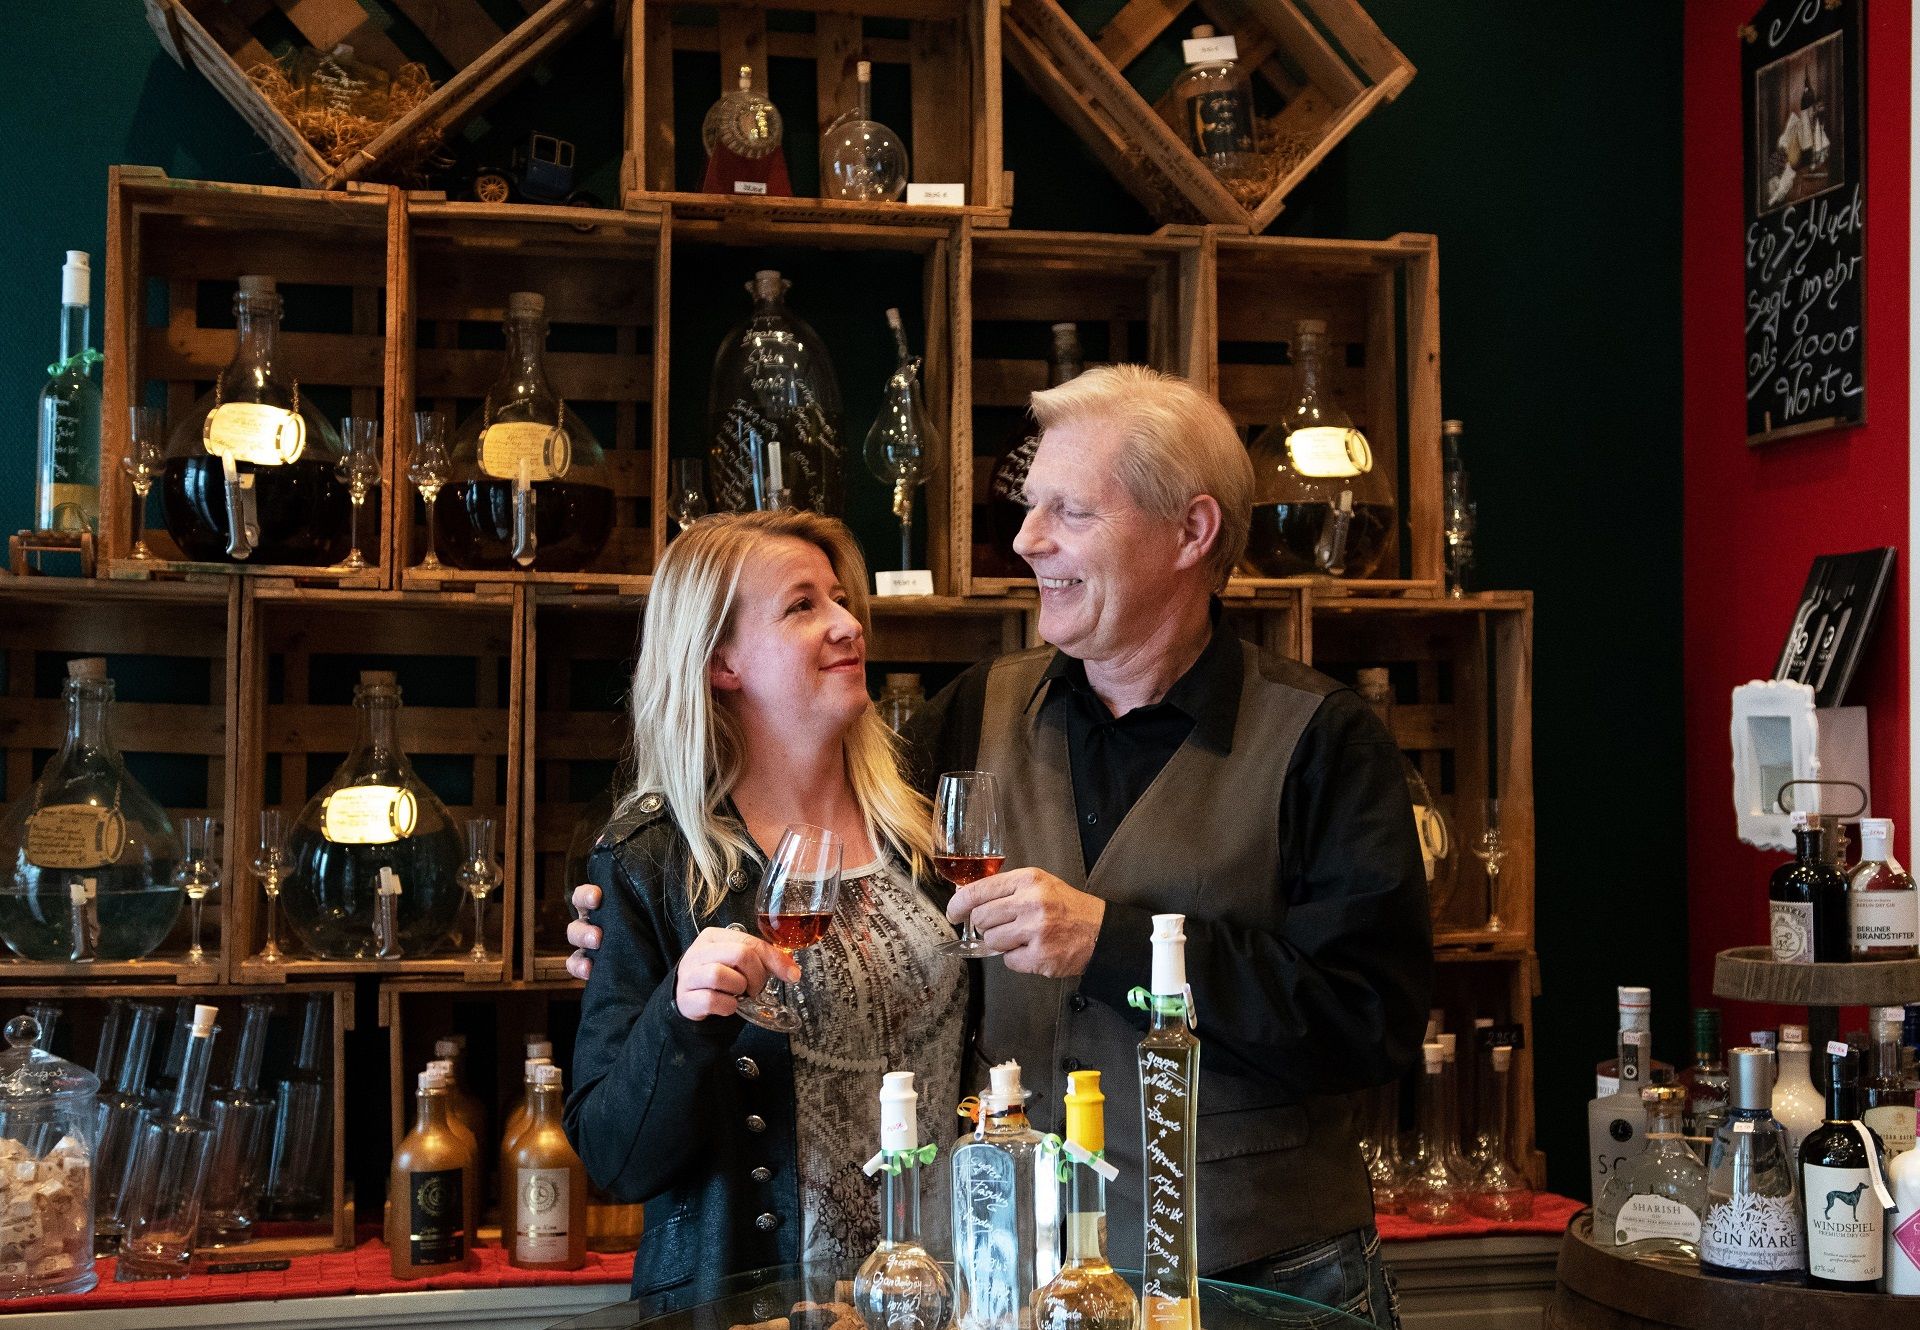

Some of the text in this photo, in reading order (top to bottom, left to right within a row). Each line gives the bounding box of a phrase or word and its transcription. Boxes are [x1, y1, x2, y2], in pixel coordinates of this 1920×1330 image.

[1746, 183, 1863, 283] Ein Schluck
[1793, 251, 1863, 336] mehr
[1746, 325, 1860, 400] als 1000
[1775, 362, 1864, 420] Worte
[1856, 931, 1915, 940] BRANDSTIFTER
[1633, 1203, 1681, 1215] SHARISH
[1813, 1219, 1876, 1233] WINDSPIEL
[1818, 1230, 1846, 1238] PREMIUM
[1712, 1230, 1742, 1247] GIN
[1748, 1234, 1798, 1248] MARE
